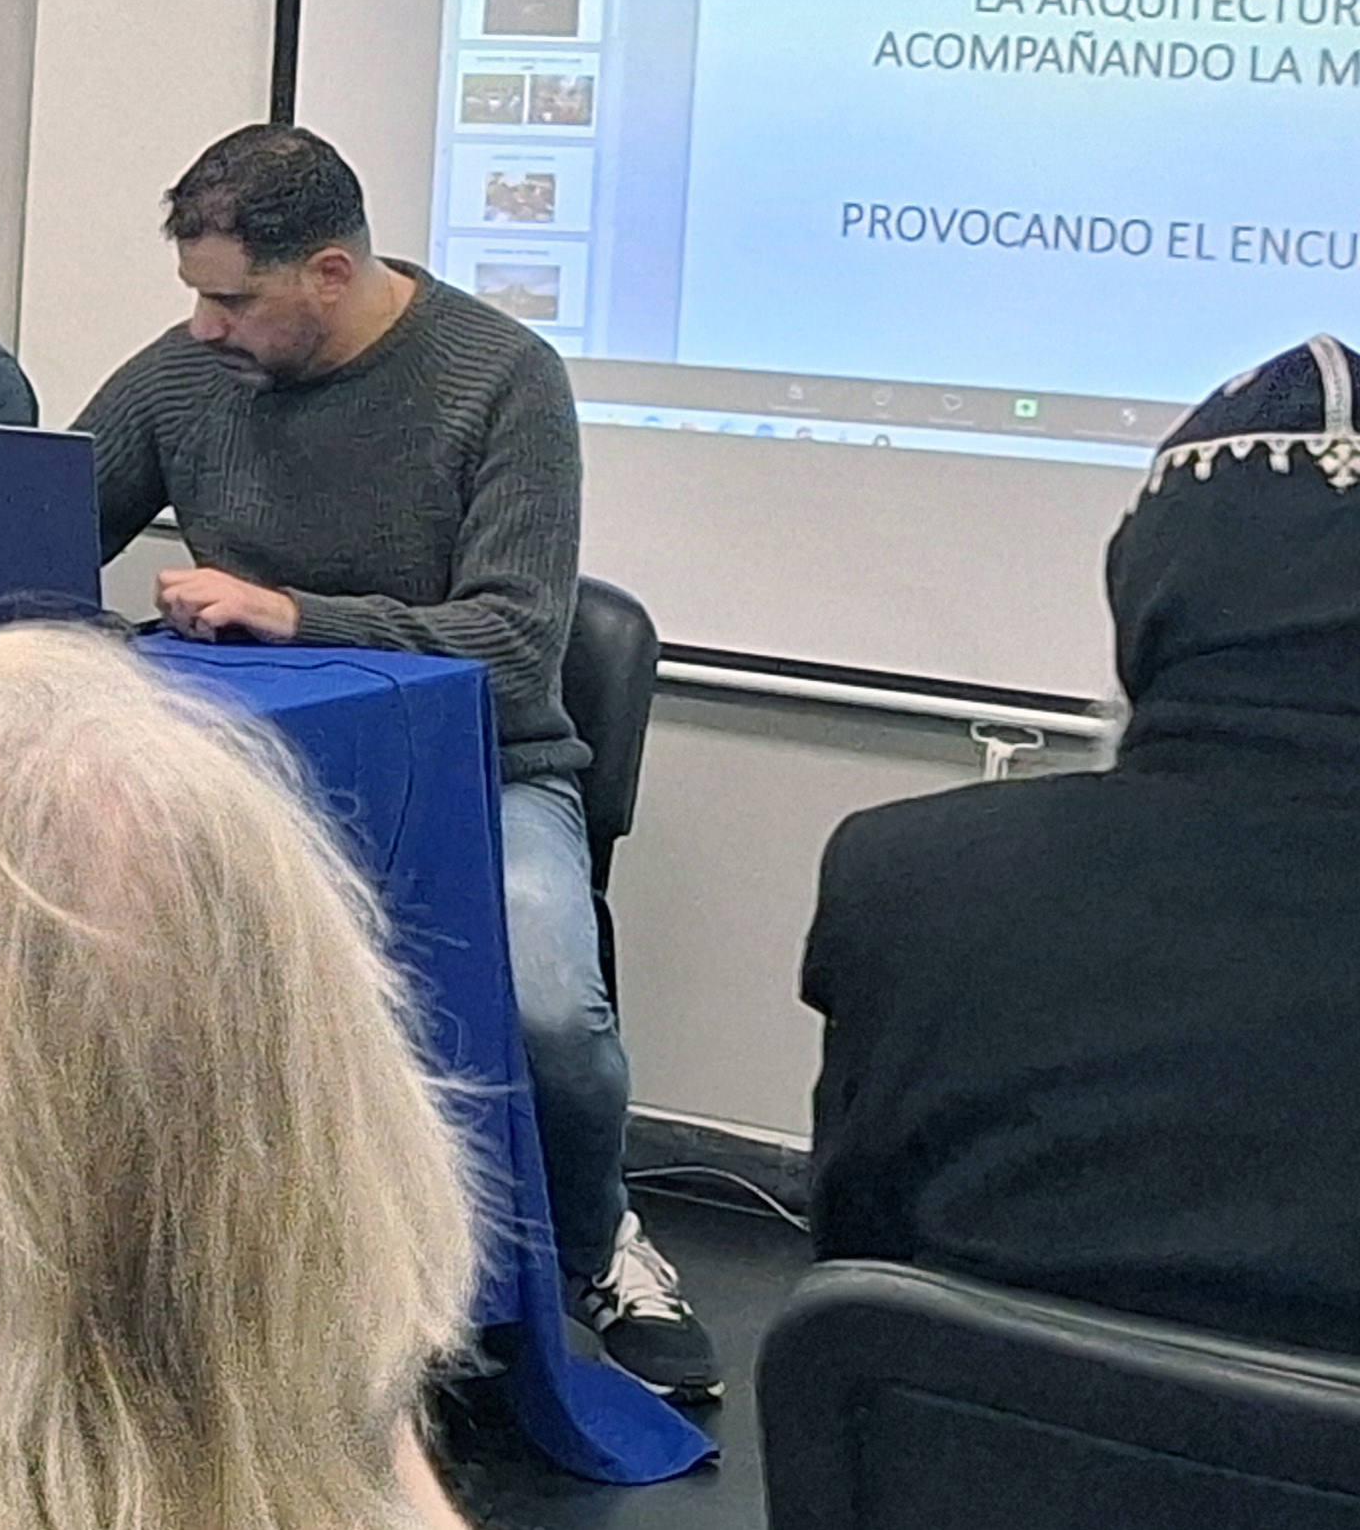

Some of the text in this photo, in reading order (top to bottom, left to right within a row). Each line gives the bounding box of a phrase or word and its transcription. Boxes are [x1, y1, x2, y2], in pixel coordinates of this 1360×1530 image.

[873, 29, 1235, 82] ACOMPAÑANDO
[1249, 46, 1302, 84] LA
[841, 202, 1359, 270] PROVOCANDO EL ENCU
